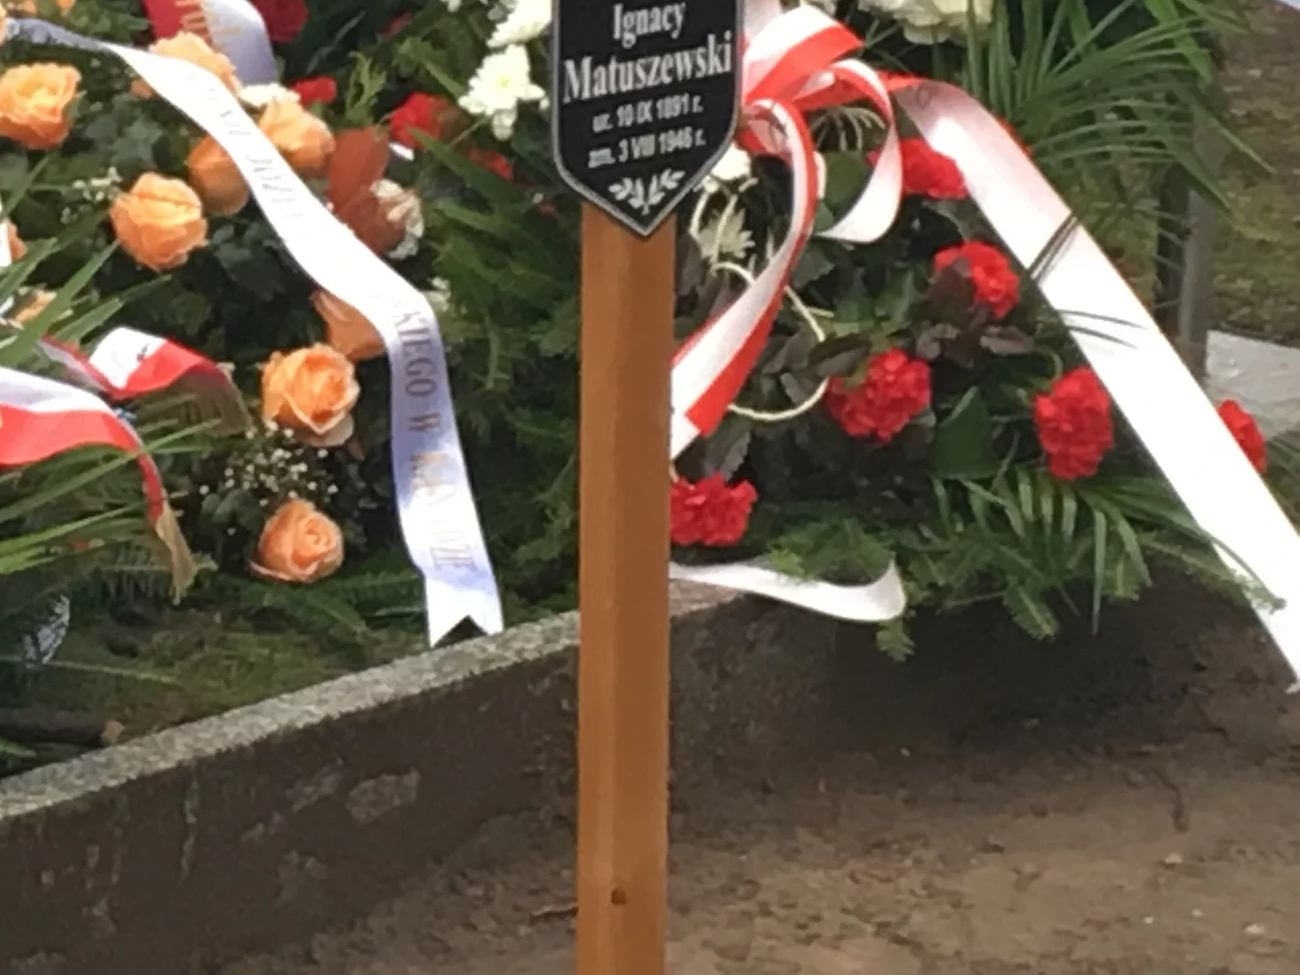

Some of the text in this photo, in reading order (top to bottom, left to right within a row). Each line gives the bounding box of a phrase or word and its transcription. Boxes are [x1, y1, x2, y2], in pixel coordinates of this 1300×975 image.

[613, 1, 686, 49] Ignacy
[563, 29, 732, 105] Matuszewski
[618, 139, 629, 163] 3
